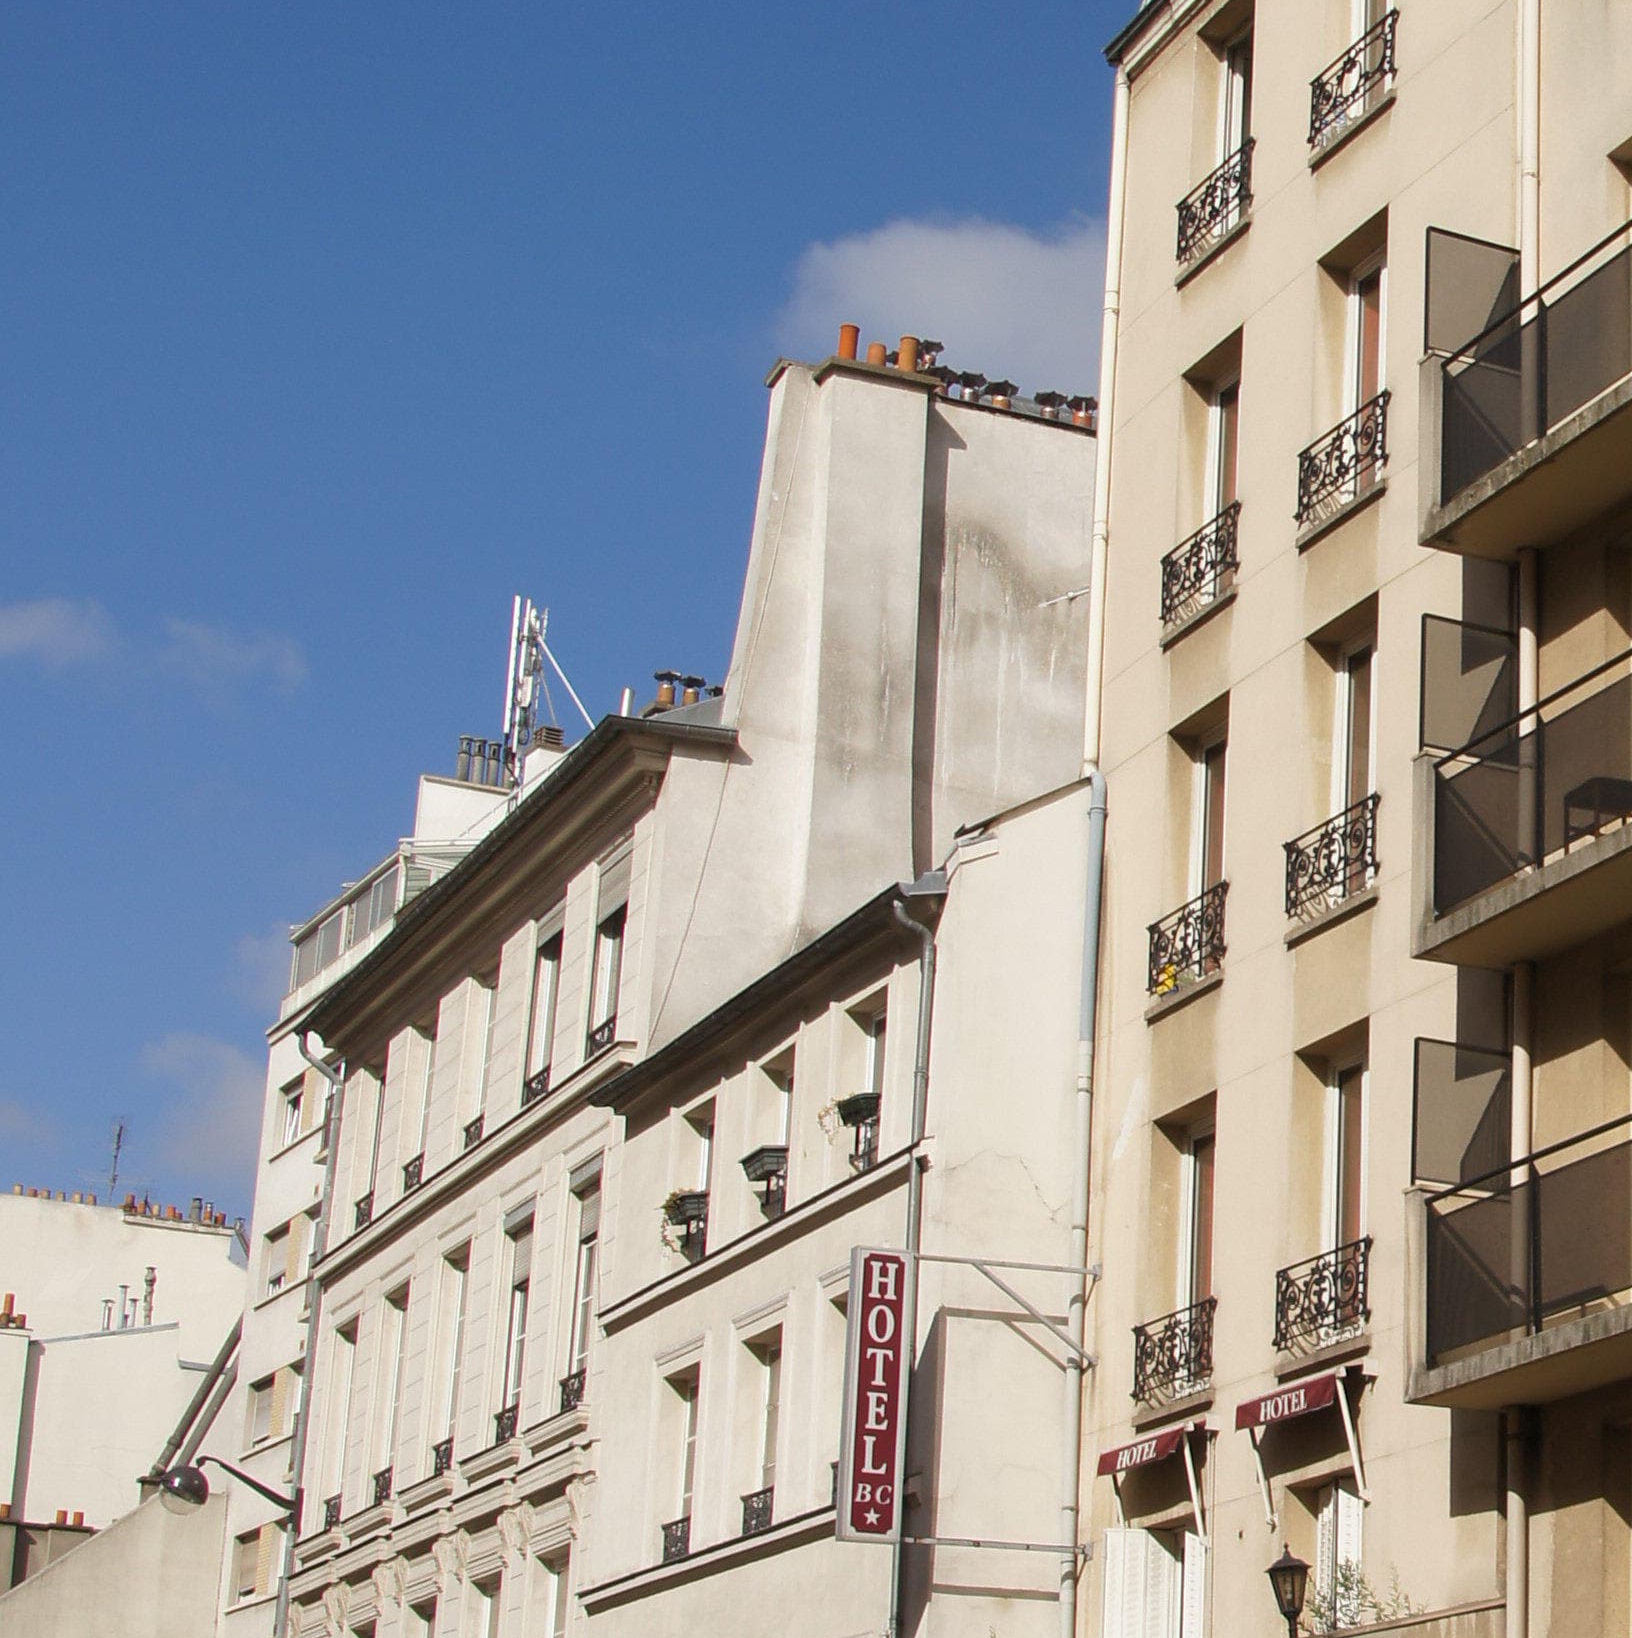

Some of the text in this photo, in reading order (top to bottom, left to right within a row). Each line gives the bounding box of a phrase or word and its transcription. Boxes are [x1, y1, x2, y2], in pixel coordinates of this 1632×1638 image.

[861, 1260, 899, 1475] HOTEL
[1259, 1388, 1308, 1422] HOTEL
[1116, 1440, 1158, 1470] HOTEL
